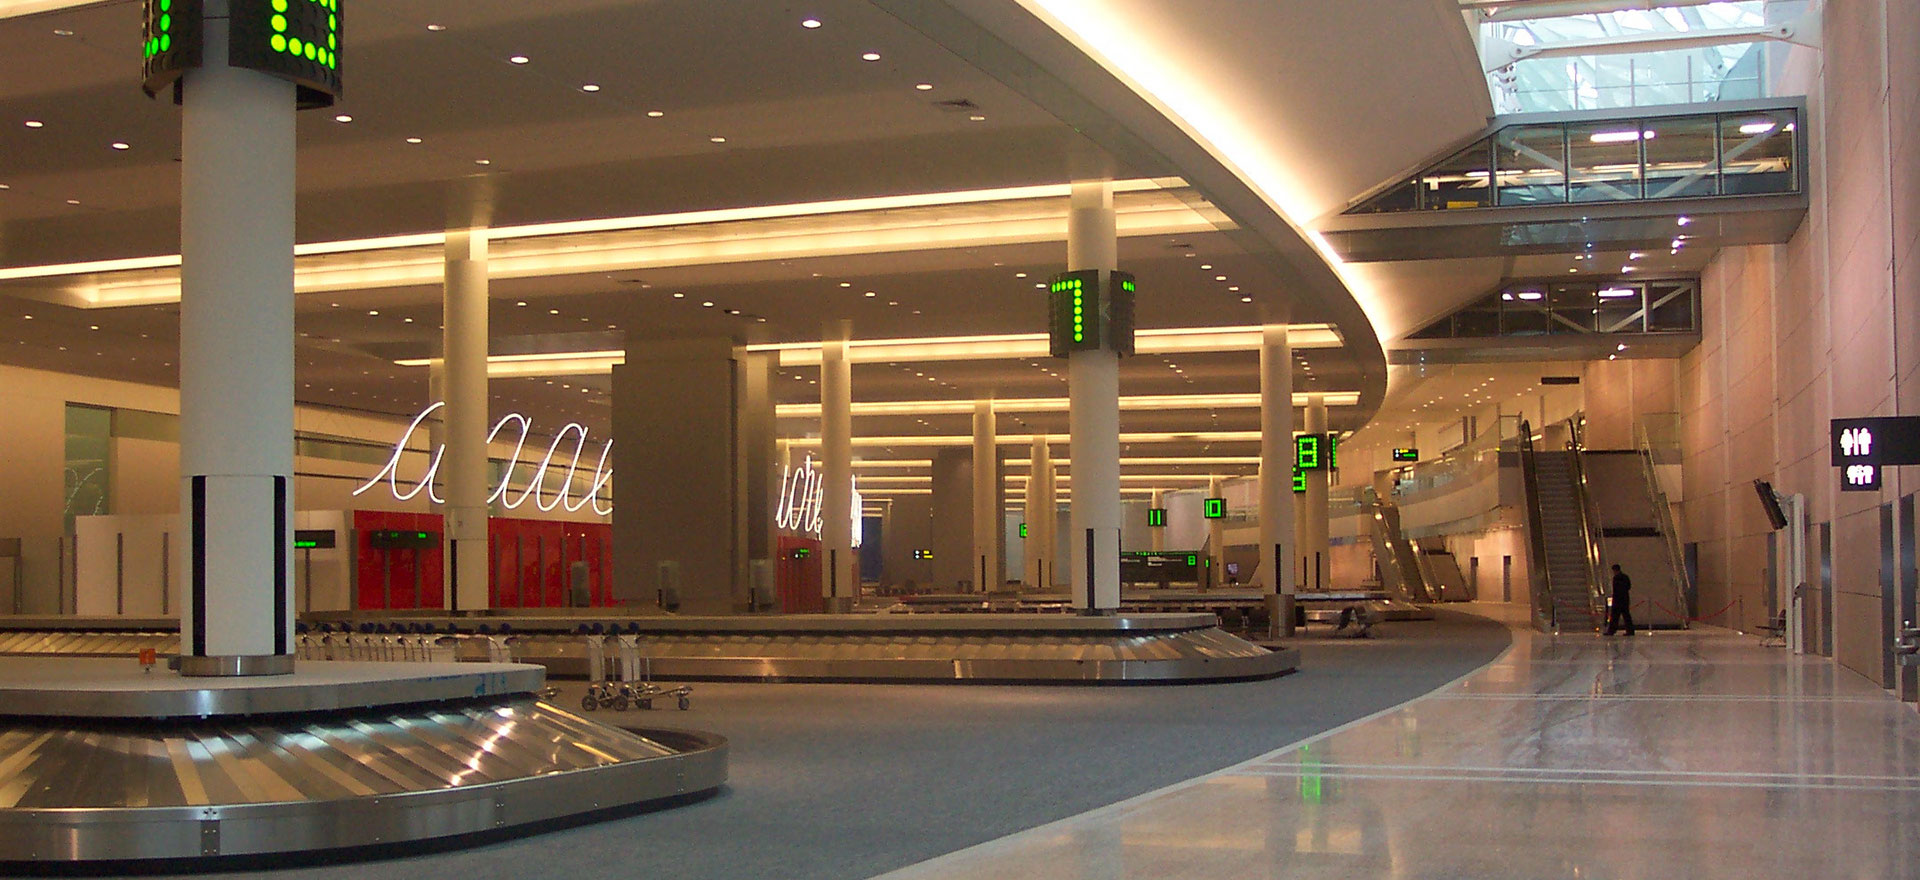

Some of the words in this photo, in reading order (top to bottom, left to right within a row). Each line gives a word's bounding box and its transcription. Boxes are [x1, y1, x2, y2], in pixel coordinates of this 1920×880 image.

[1051, 279, 1083, 342] 7
[1298, 437, 1318, 468] 8
[1149, 509, 1161, 526] 11
[1205, 499, 1222, 518] 10
